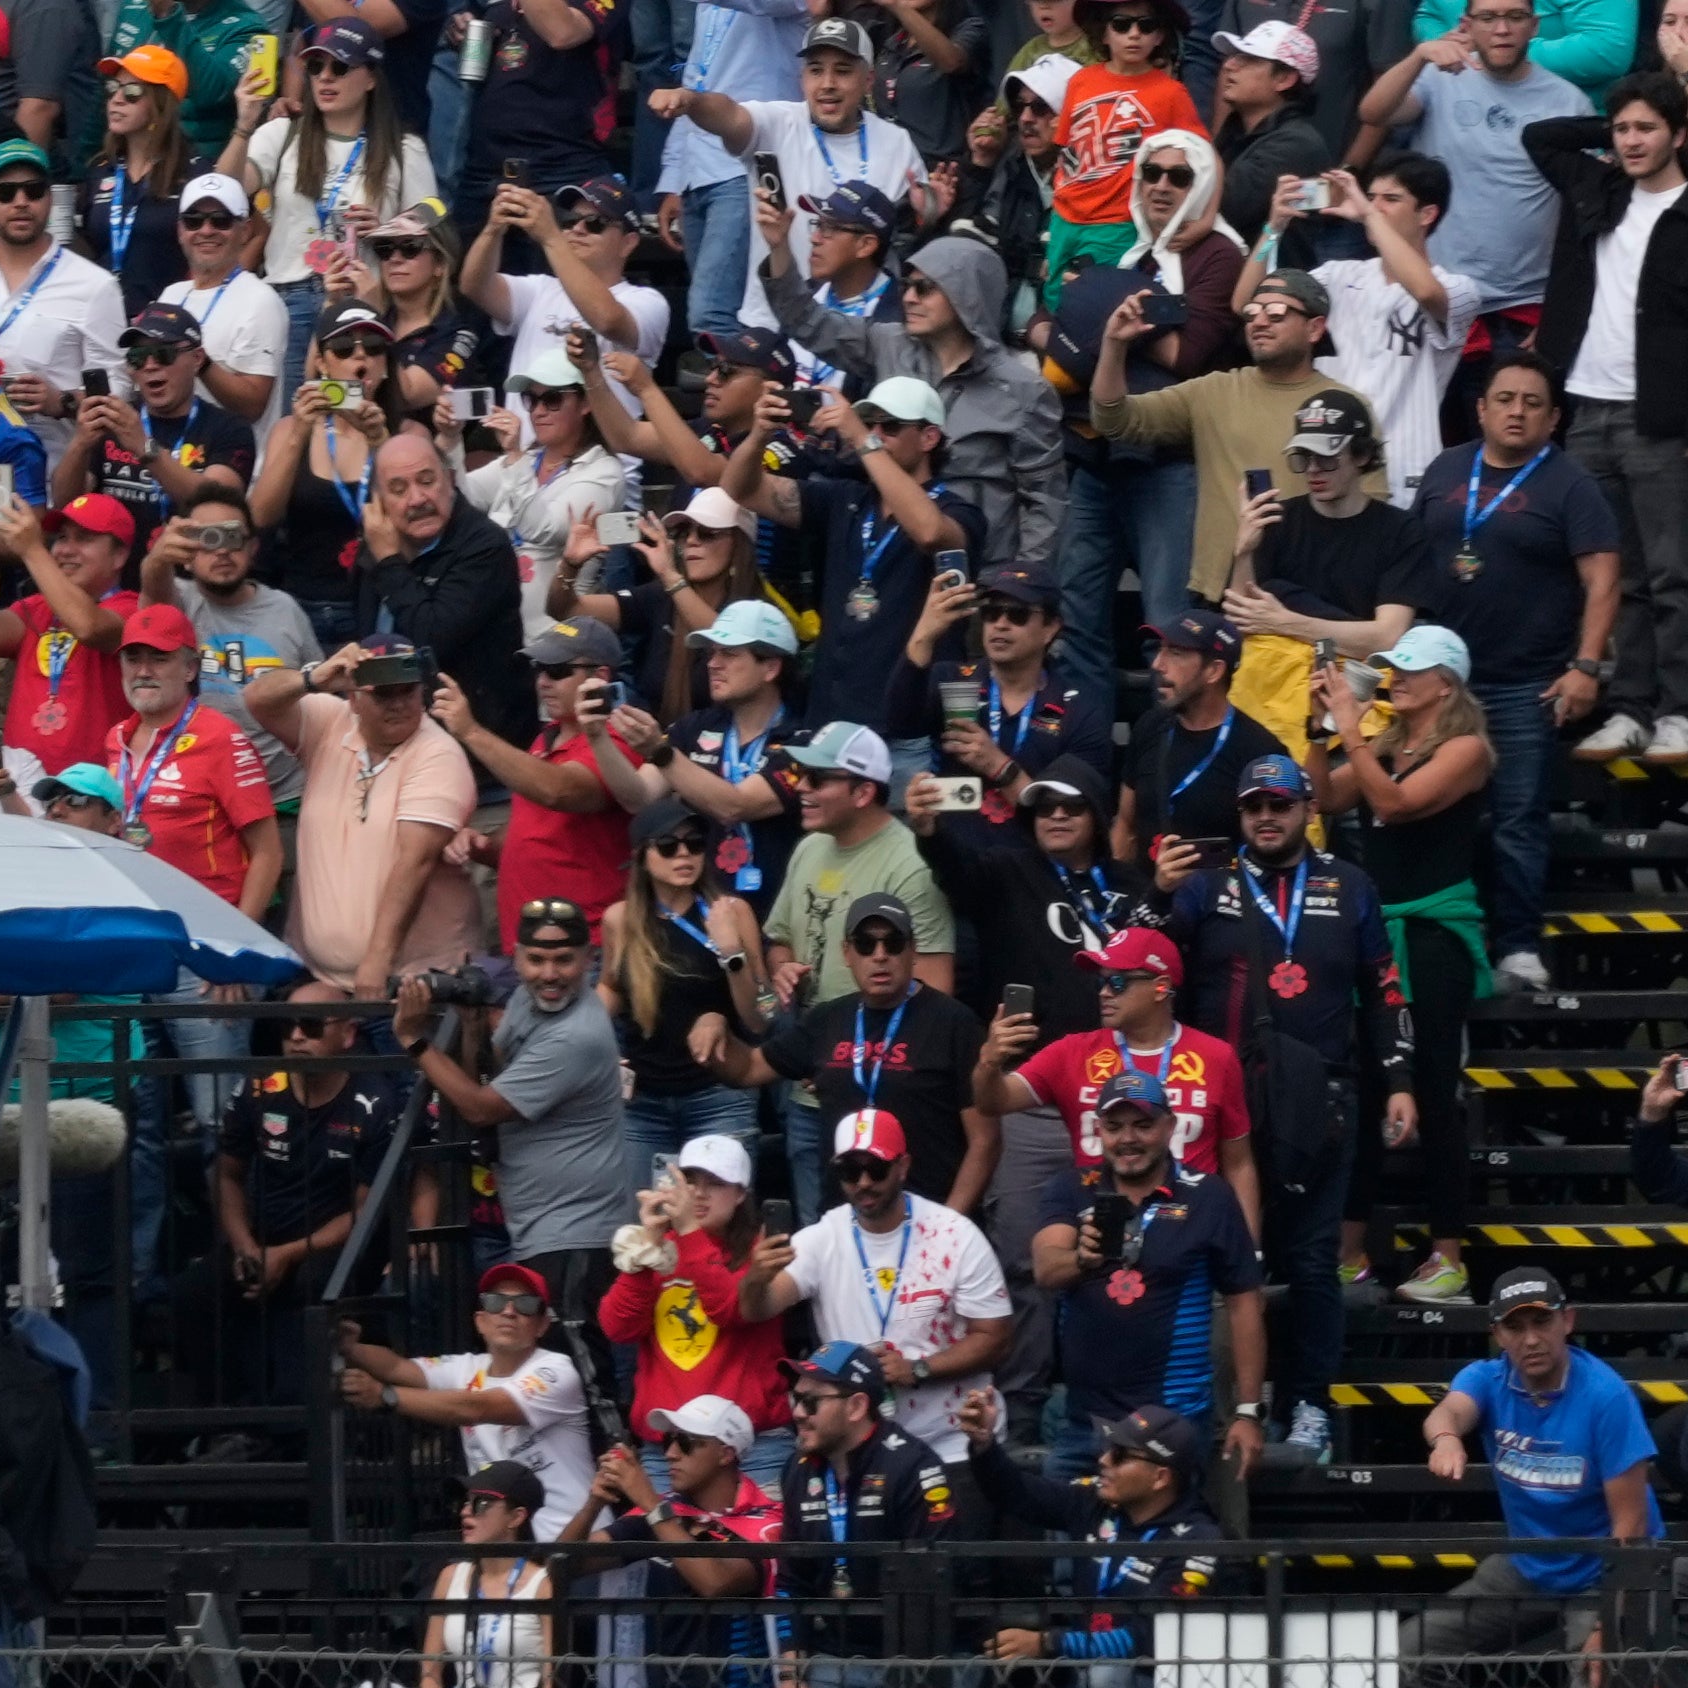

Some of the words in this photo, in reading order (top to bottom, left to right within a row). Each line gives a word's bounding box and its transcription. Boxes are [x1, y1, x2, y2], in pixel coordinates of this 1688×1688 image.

[1625, 834, 1648, 850] 07
[1557, 997, 1581, 1010] 06
[834, 1040, 910, 1065] BOSS
[1488, 1151, 1510, 1165] 05
[1422, 1311, 1444, 1324] 04
[1350, 1471, 1373, 1484] 03
